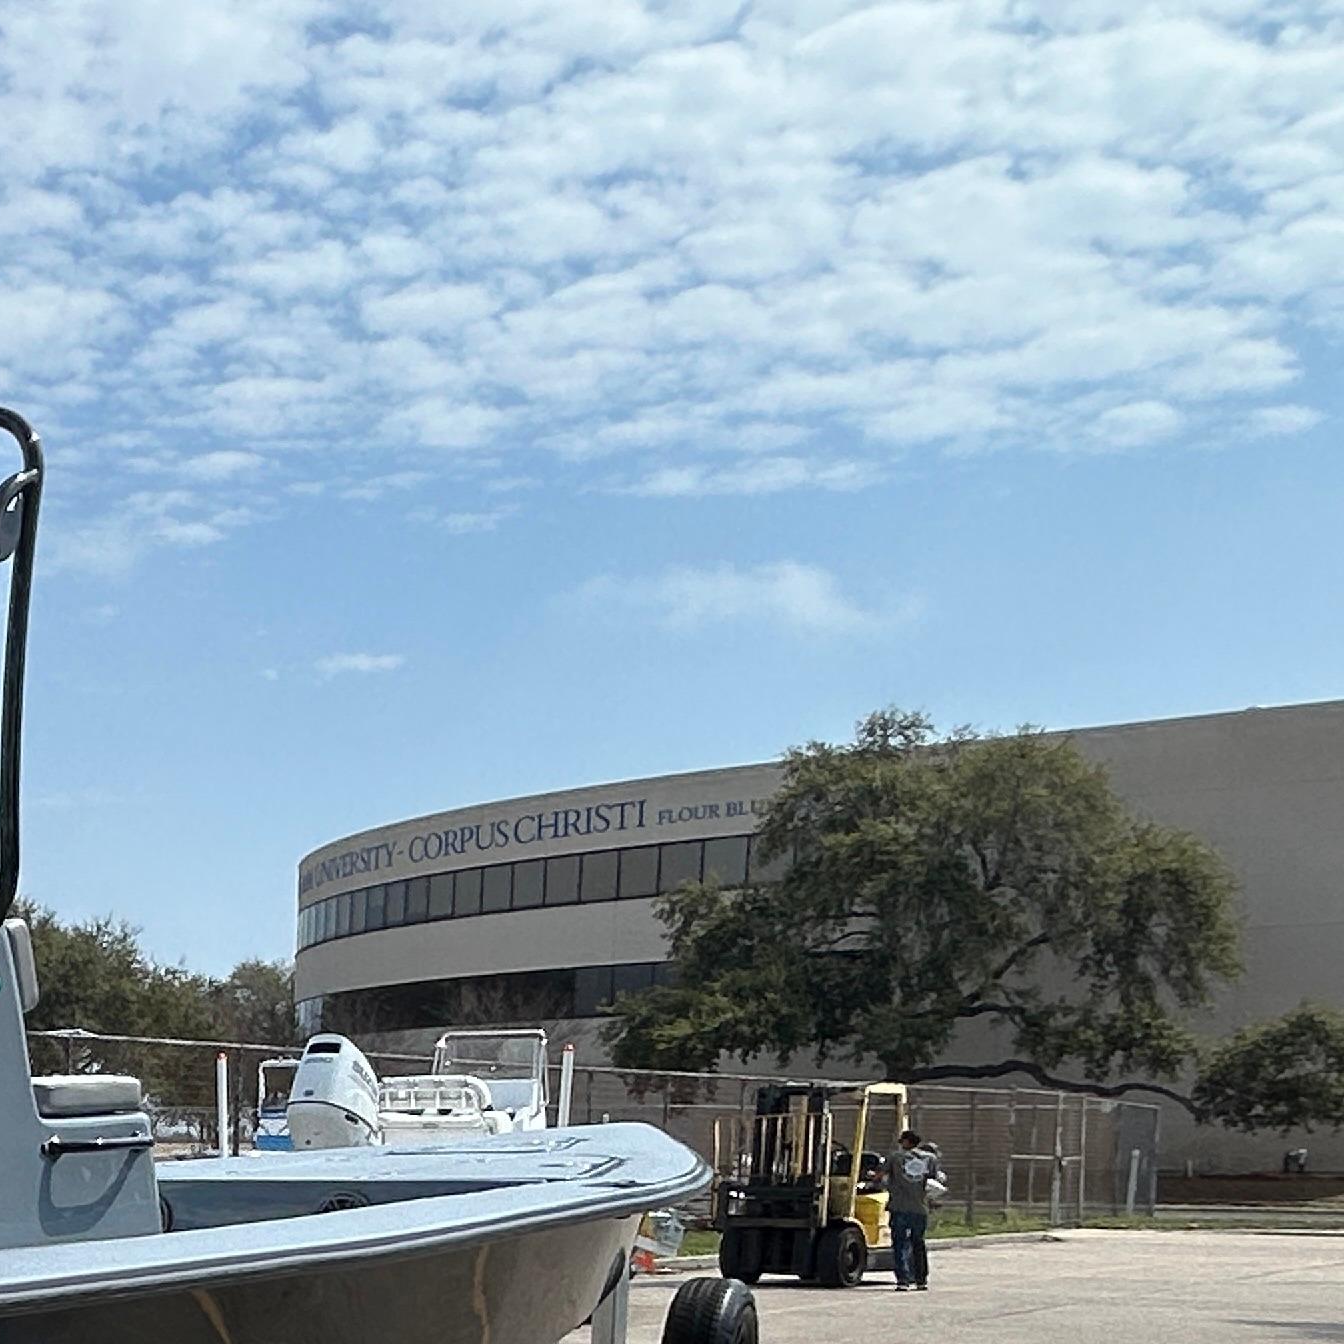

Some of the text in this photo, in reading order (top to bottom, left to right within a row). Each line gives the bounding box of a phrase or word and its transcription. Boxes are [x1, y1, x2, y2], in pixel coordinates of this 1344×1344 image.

[408, 820, 510, 863] CORPUS
[514, 799, 647, 844] CHRISTI
[656, 804, 720, 826] FLOUR
